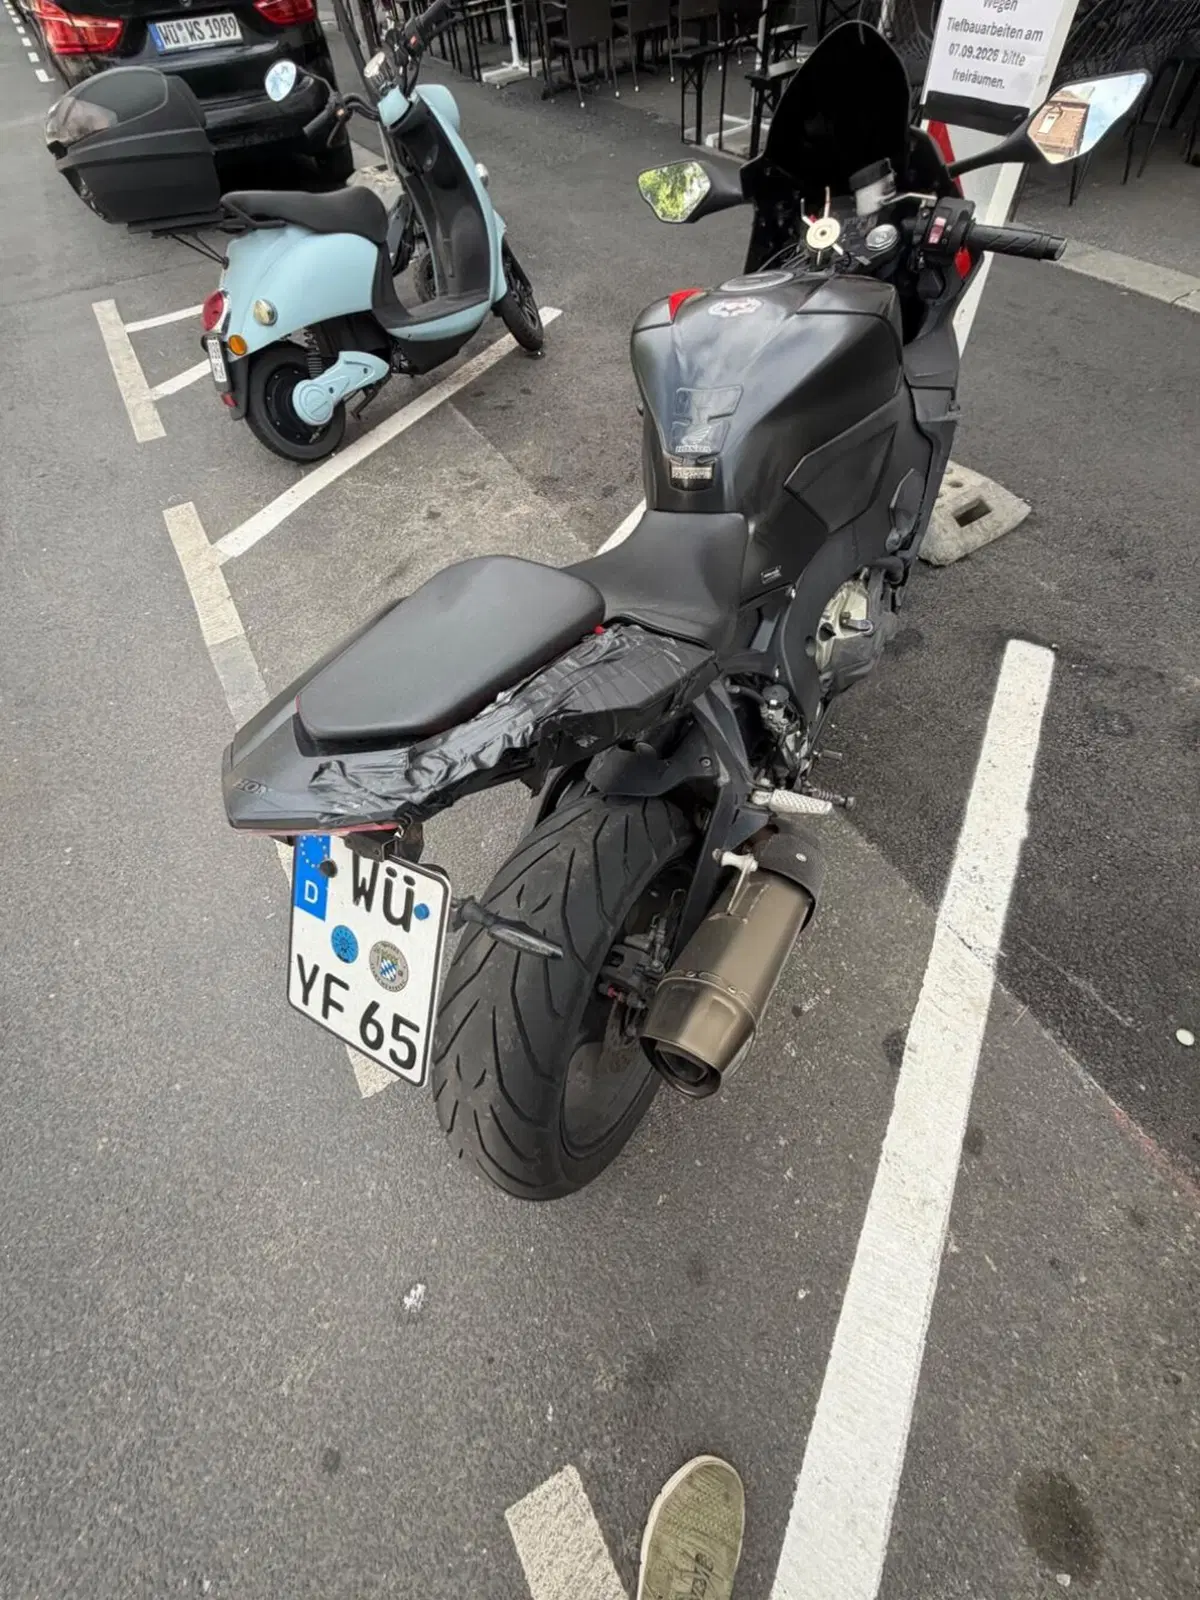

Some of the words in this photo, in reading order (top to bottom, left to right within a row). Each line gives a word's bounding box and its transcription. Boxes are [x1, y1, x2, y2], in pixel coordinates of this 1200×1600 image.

[983, 0, 1017, 13] Wegen
[205, 16, 237, 39] 1989
[947, 17, 1023, 39] Tiefbauarbeiten
[1024, 28, 1044, 42] am
[1001, 49, 1026, 67] bitte
[952, 68, 1005, 88] freiräumen.
[304, 879, 319, 904] D
[352, 849, 416, 933] WÜ
[297, 953, 350, 1020] YF
[359, 1000, 420, 1070] 65
